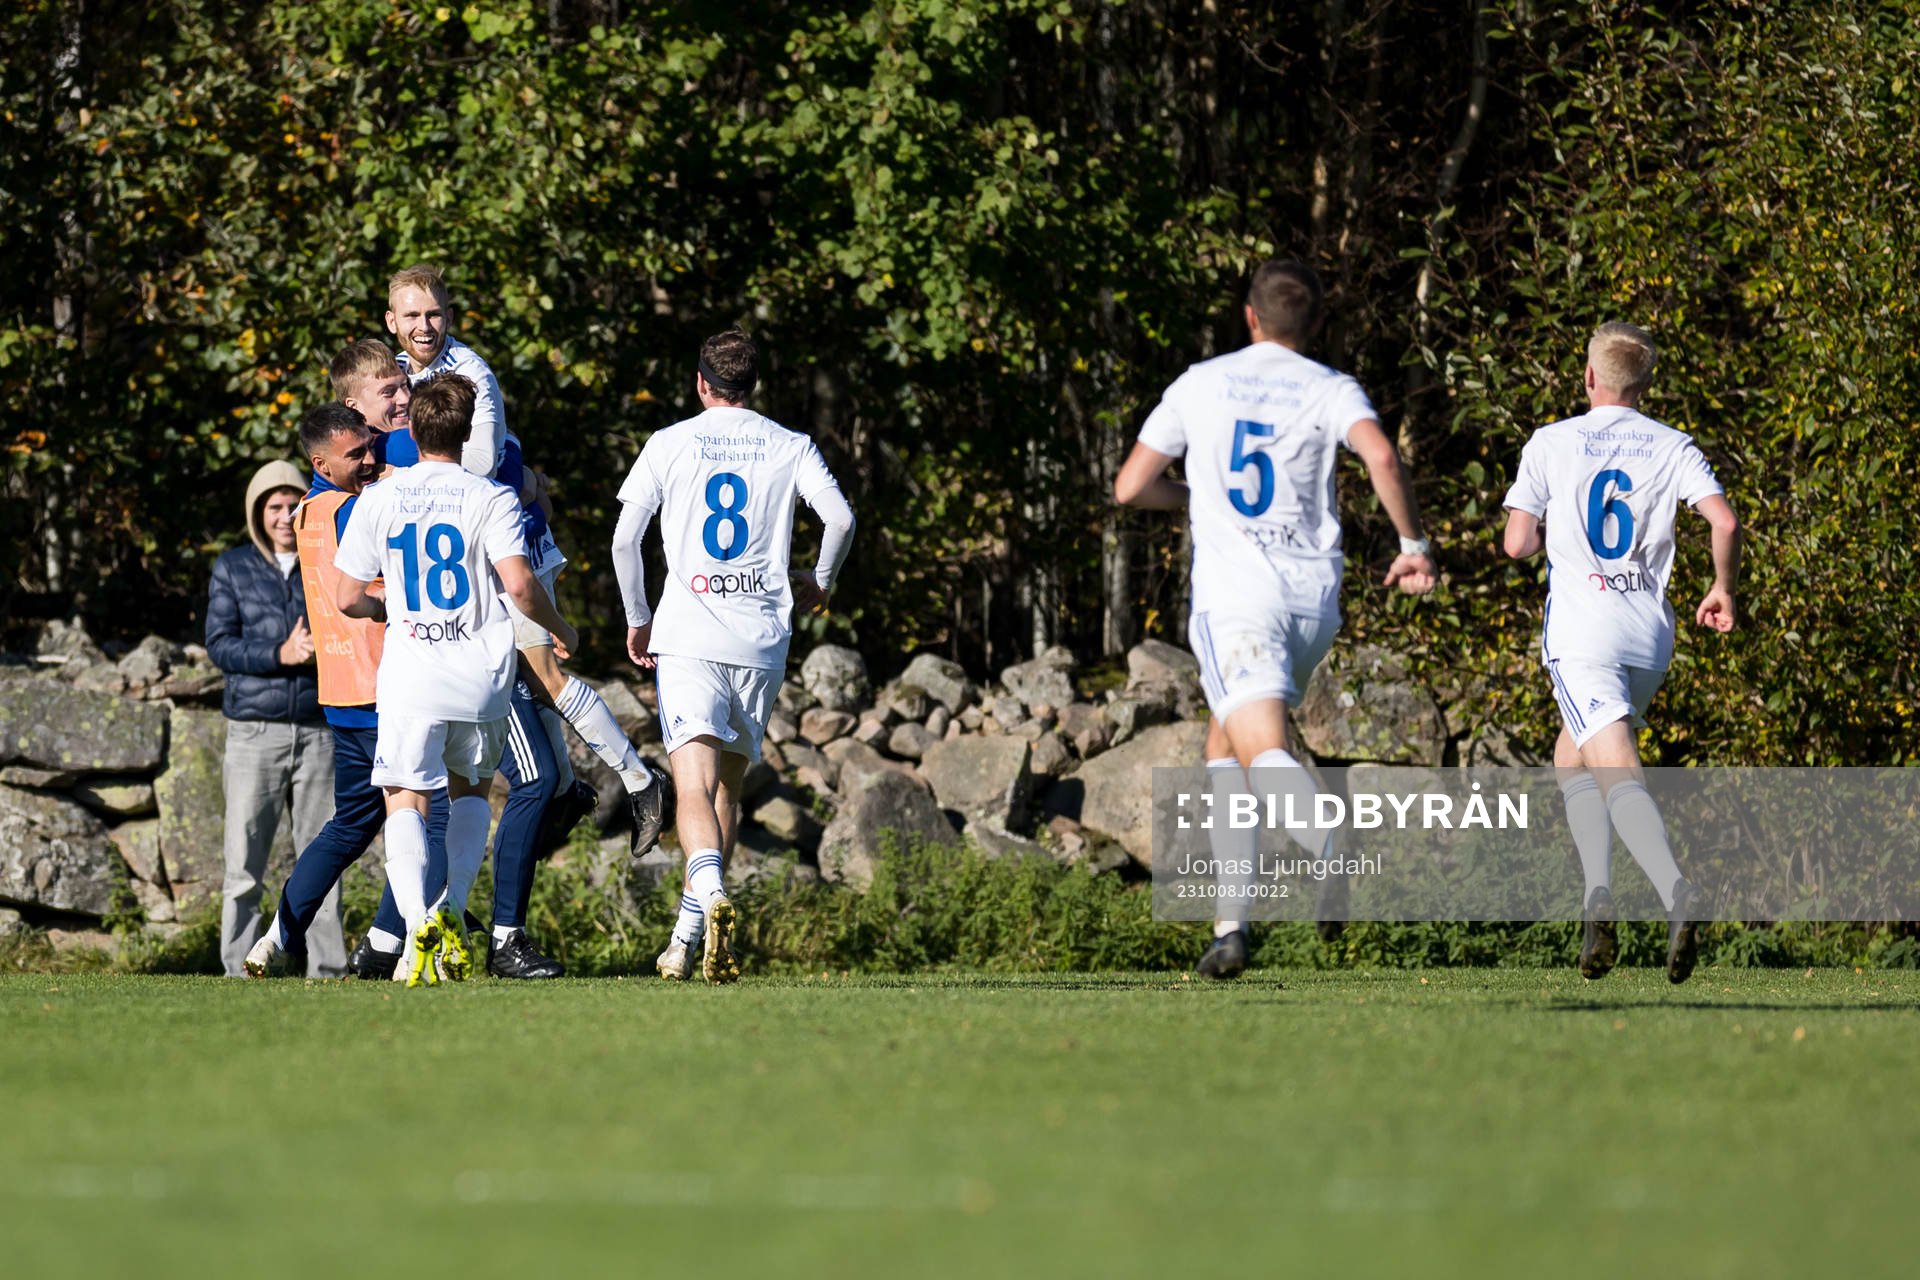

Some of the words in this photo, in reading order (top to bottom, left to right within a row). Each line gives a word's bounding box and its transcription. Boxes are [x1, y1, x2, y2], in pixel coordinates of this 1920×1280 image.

[694, 432, 766, 447] Sparbanken
[1229, 420, 1275, 518] 5
[702, 472, 749, 561] 8
[1587, 468, 1634, 560] 6
[387, 523, 470, 612] 18
